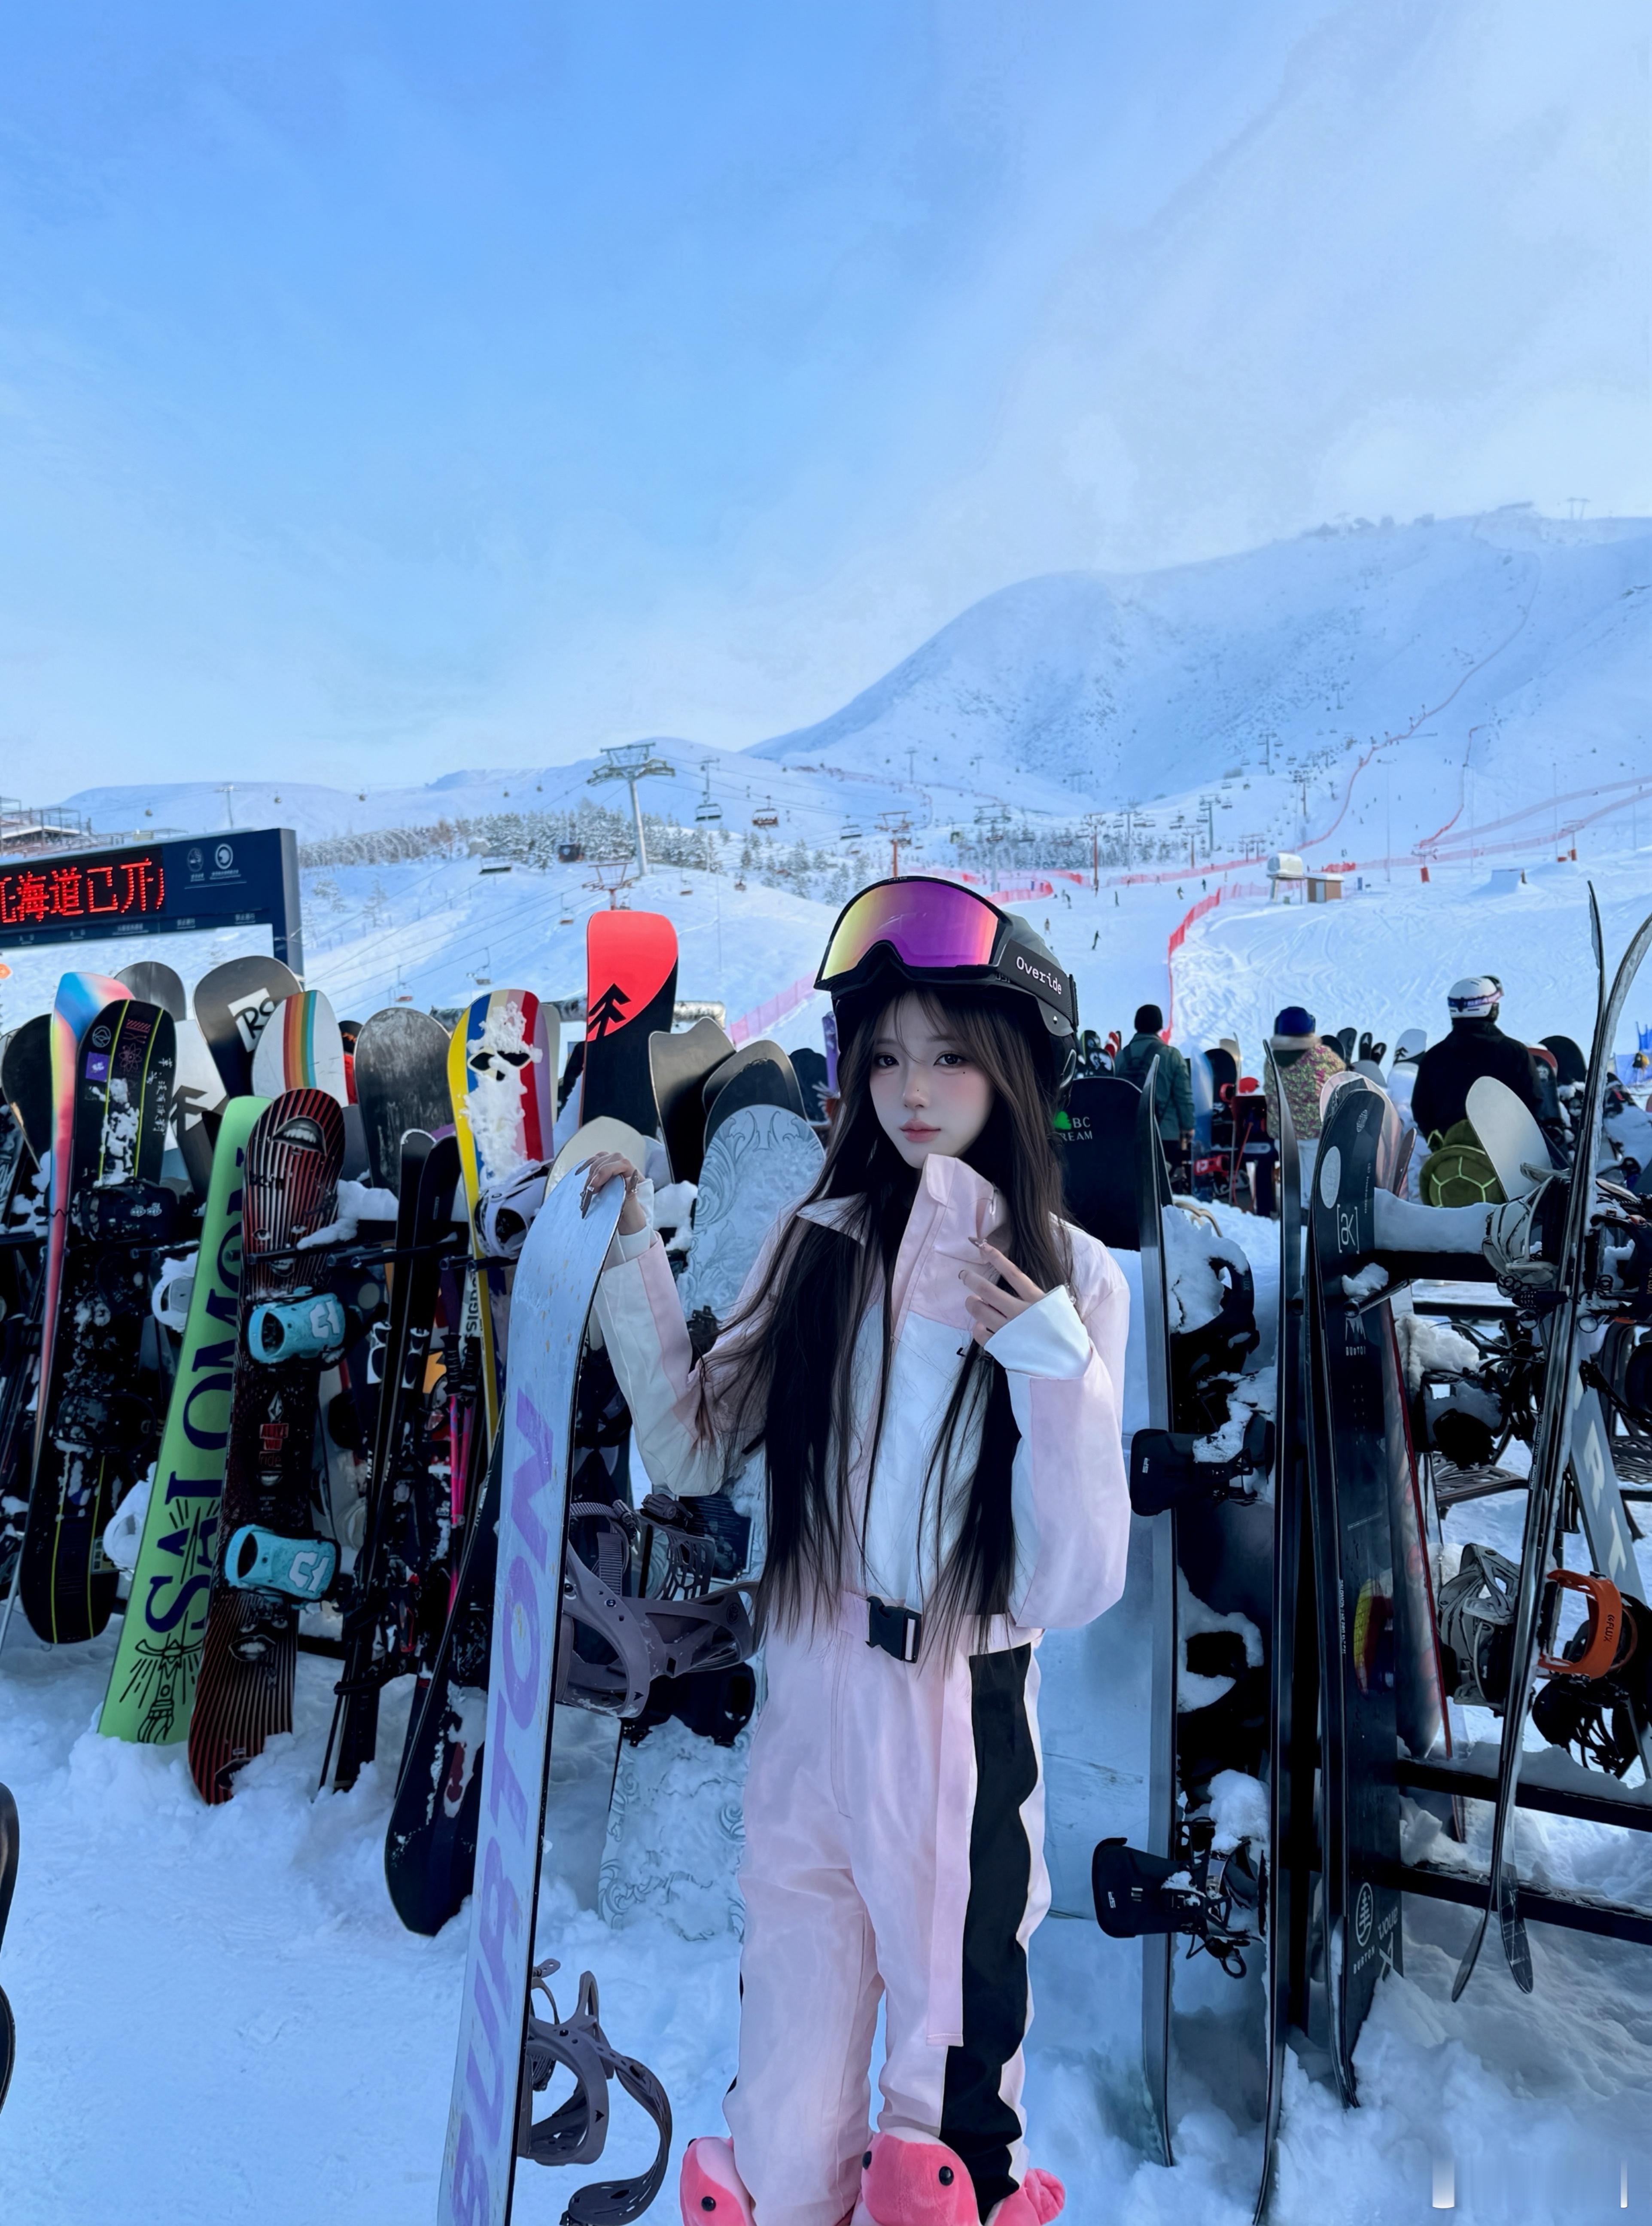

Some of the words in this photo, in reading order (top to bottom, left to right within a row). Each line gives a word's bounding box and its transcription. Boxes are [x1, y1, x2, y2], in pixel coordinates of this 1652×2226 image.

[1016, 956, 1062, 995] Overide
[1072, 1116, 1091, 1129] BC
[1059, 1130, 1093, 1142] REAM
[1603, 1621, 1615, 1643] FLUX
[452, 1386, 553, 2226] BURTON
[1353, 1944, 1375, 1975] BURTON
